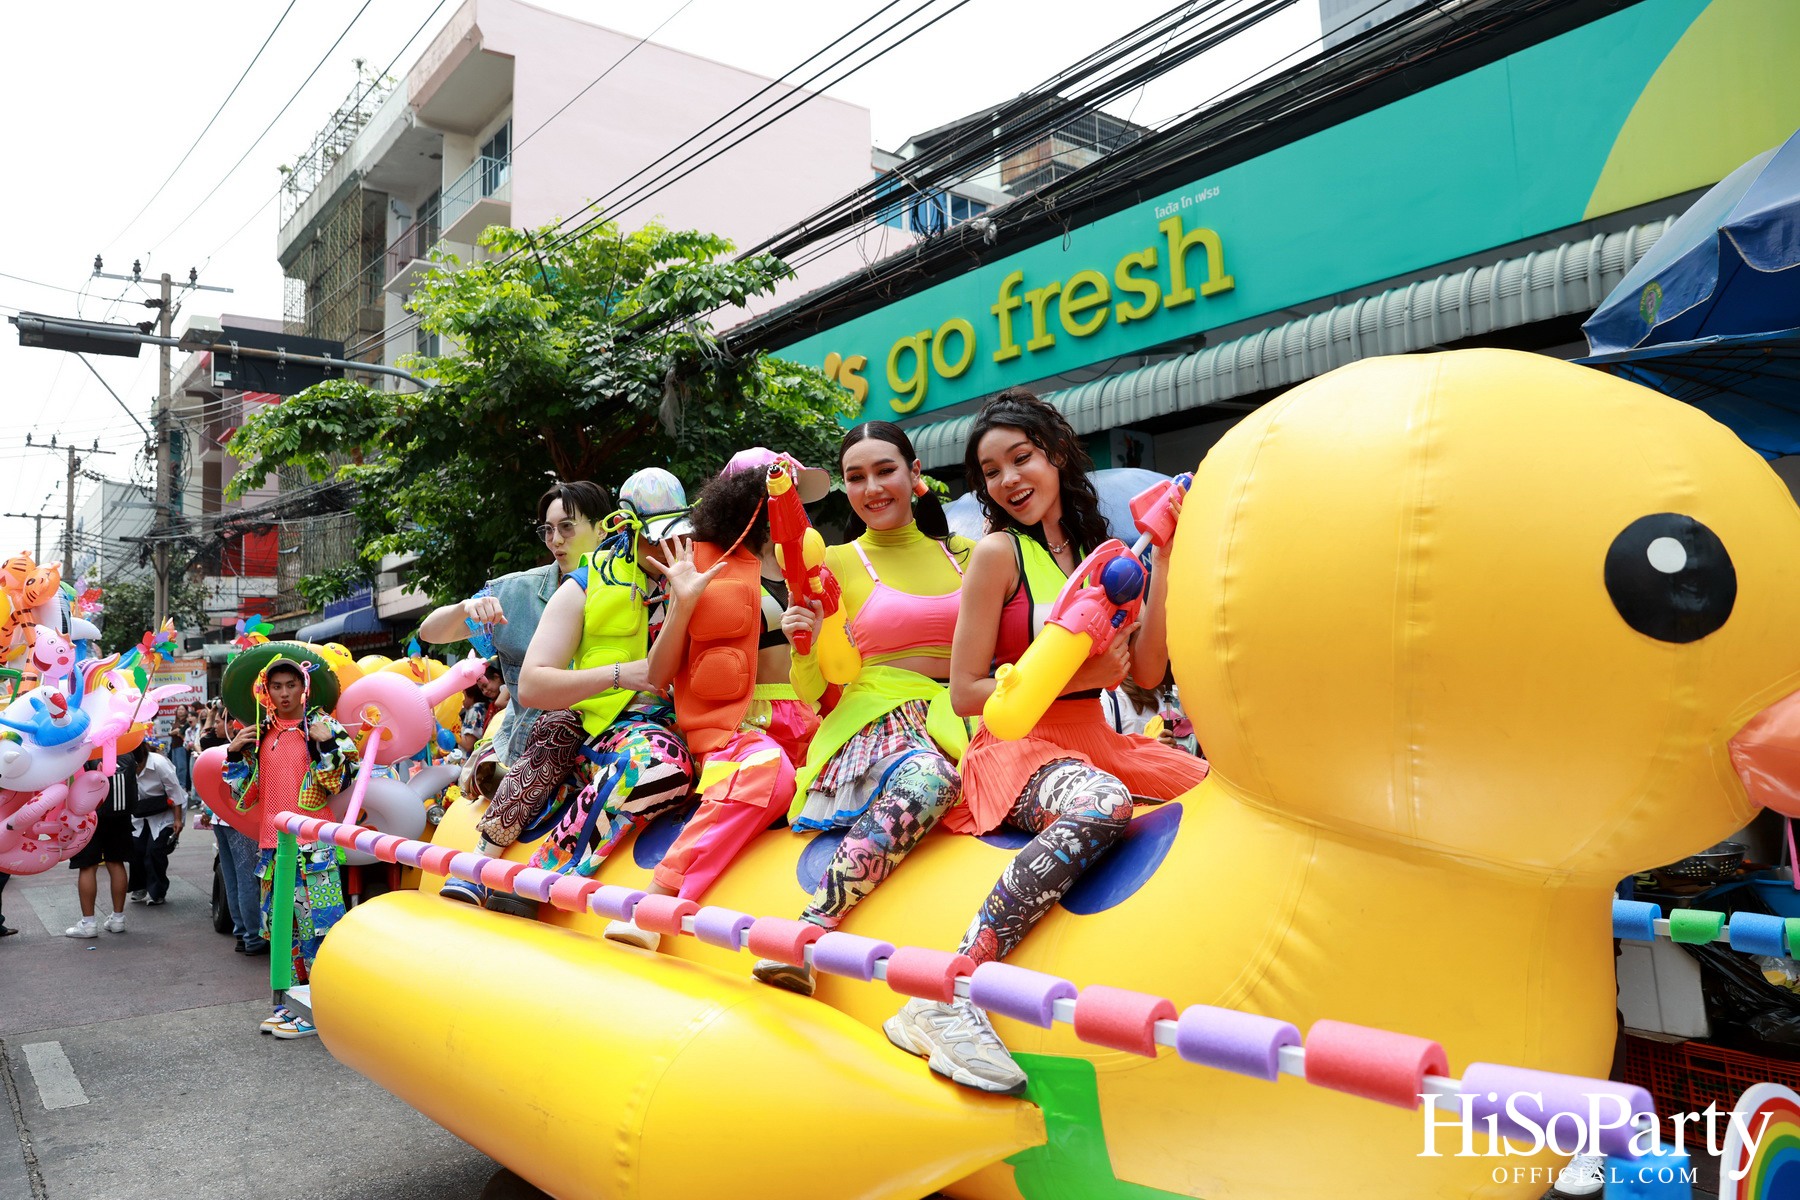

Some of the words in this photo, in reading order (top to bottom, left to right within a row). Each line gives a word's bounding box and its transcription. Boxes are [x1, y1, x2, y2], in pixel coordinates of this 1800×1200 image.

[1154, 202, 1180, 219] โลตัส
[1181, 196, 1193, 209] โก
[1195, 186, 1221, 203] เฟรช
[886, 317, 976, 414] go
[991, 215, 1236, 363] fresh
